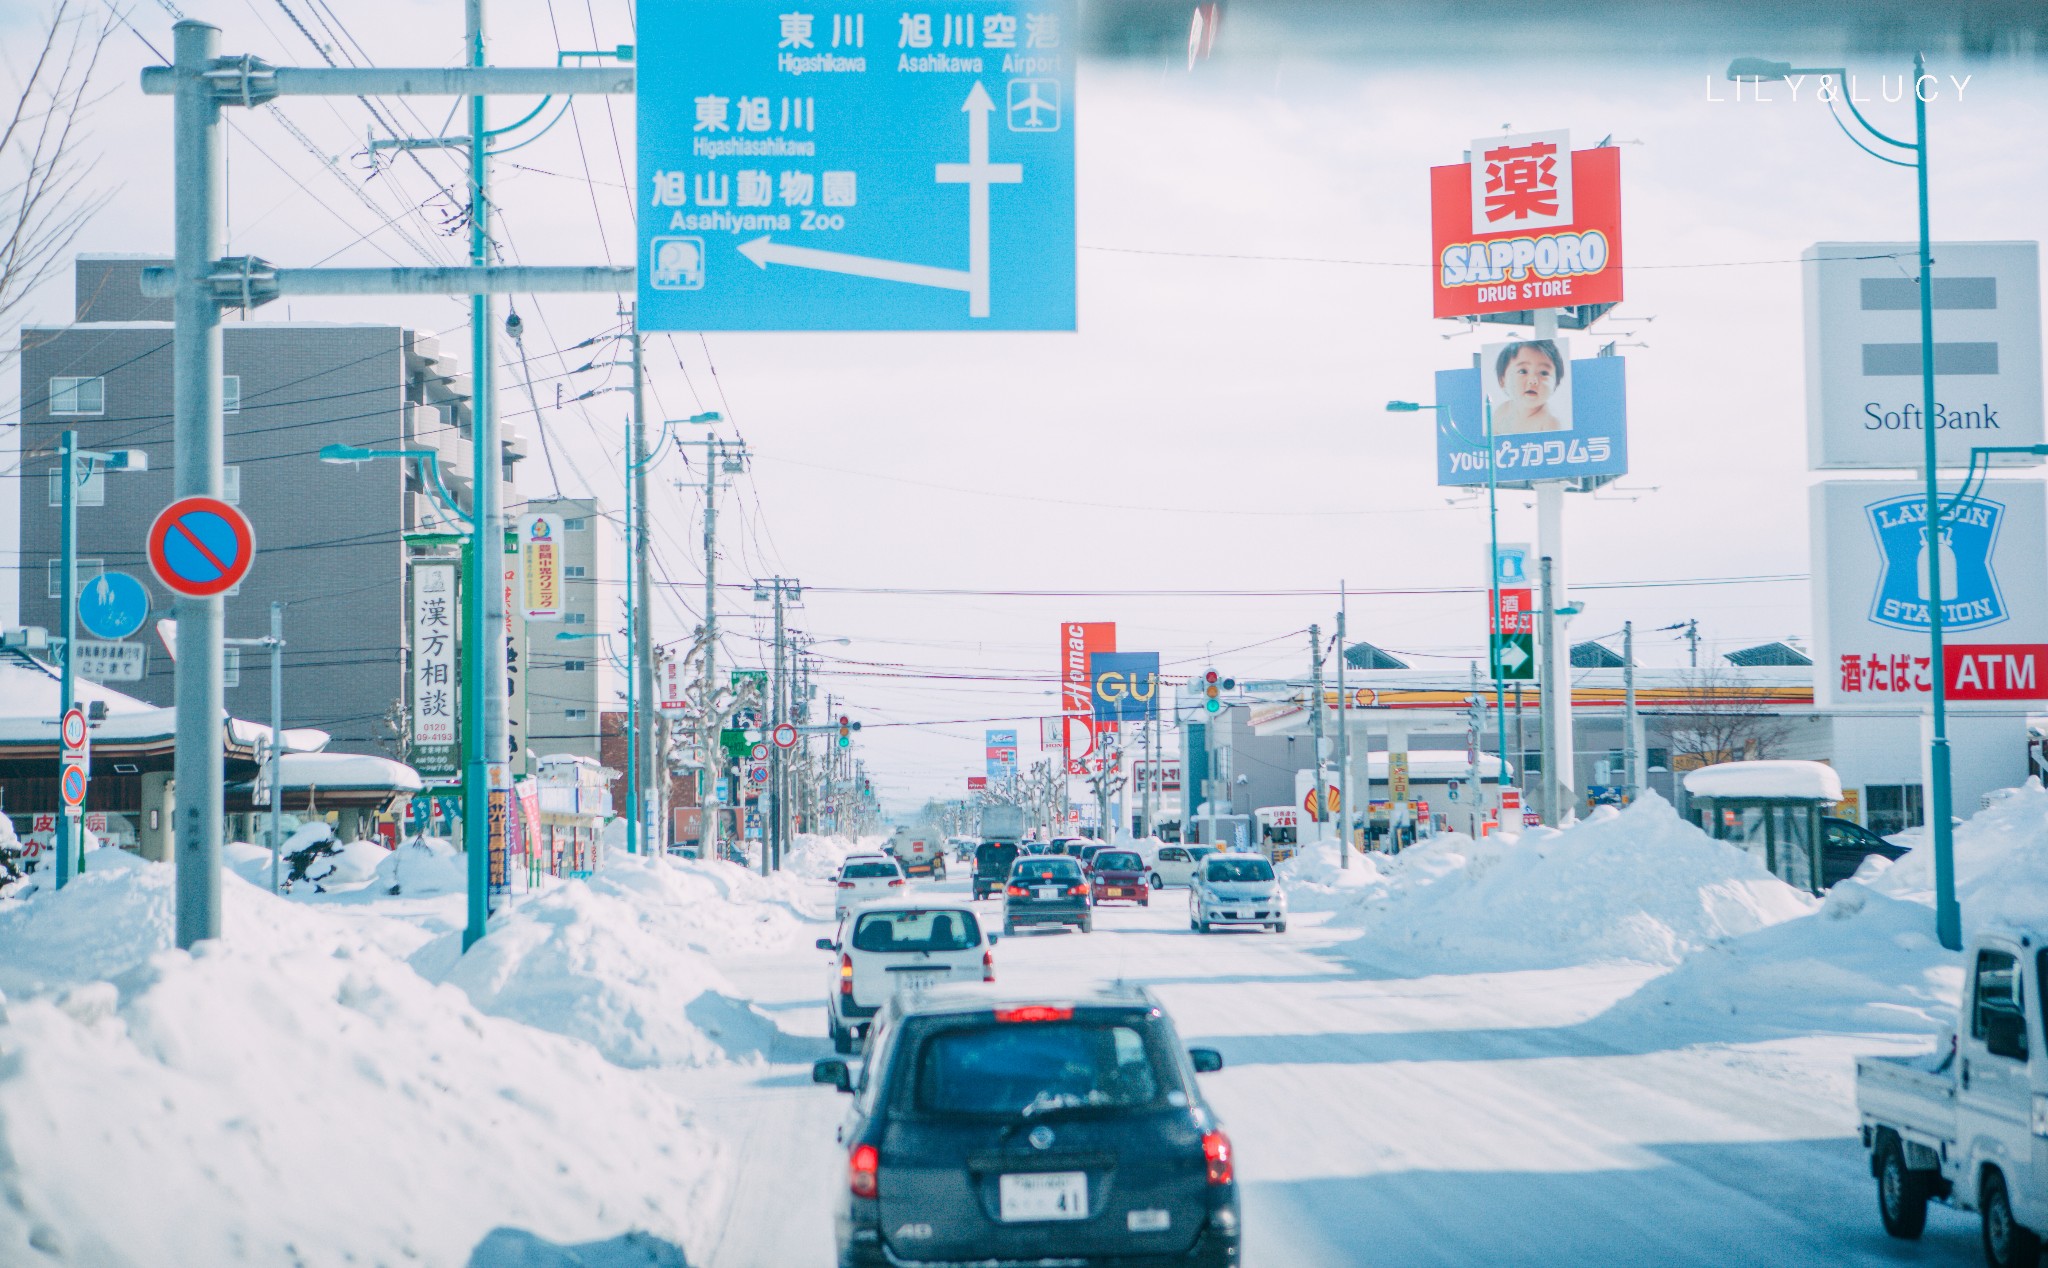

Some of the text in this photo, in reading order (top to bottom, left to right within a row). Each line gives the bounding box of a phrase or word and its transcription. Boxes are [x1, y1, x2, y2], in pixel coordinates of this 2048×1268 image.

[778, 12, 1060, 48] 東川 旭川空港
[778, 54, 866, 75] Higashikawa
[897, 54, 983, 73] Asahikawa
[693, 96, 815, 133] 東旭川
[693, 137, 815, 158] Higashiasahikawa
[652, 170, 857, 207] 旭山動物園
[1484, 141, 1559, 223] 薬
[670, 211, 845, 233] Asahiyama Zoo
[1440, 230, 1609, 289] SAPPORO
[1477, 279, 1572, 304] DRUG STORE
[1864, 402, 2001, 432] SoftBank
[420, 598, 451, 718] 漢方相談
[1064, 625, 1093, 708] Homac
[1954, 654, 2036, 690] ATM
[1096, 672, 1155, 702] GU
